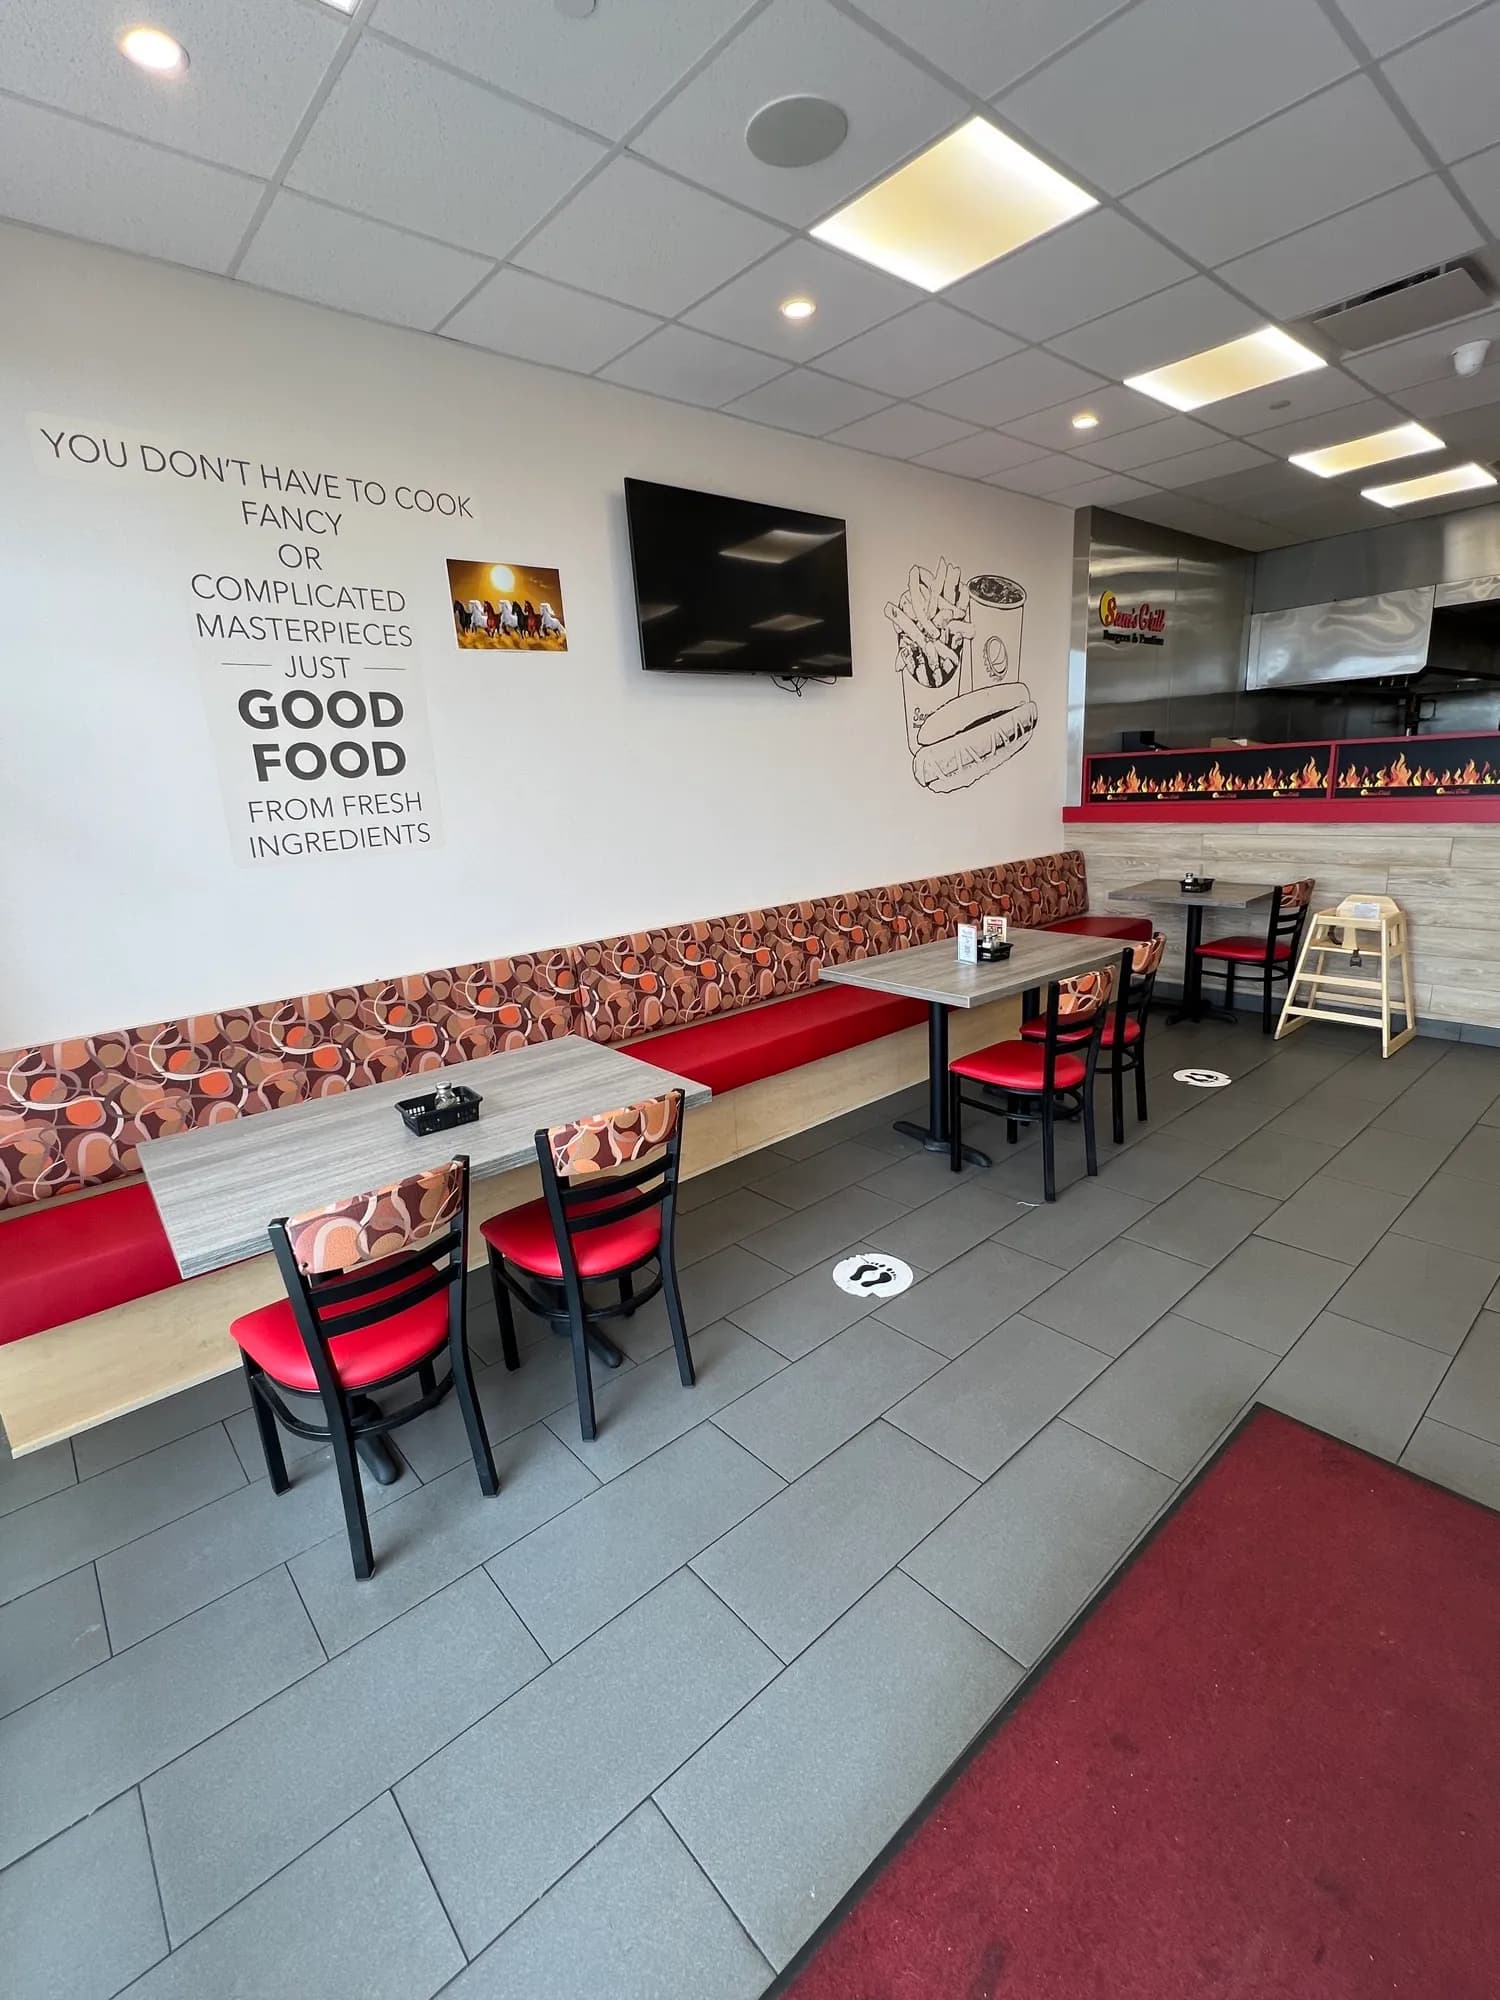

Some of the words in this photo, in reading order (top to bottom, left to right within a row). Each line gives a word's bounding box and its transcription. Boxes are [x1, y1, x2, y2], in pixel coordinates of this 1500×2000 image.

[40, 428, 127, 468] YOU
[140, 445, 251, 487] DON'T
[260, 465, 341, 500] HAVE
[346, 478, 387, 507] TO
[395, 486, 474, 519] COOK
[241, 501, 342, 537] FANCY
[278, 543, 322, 571] OR
[191, 573, 406, 613] COMPLICATED
[195, 614, 413, 648] MASTERPIECES
[1139, 603, 1167, 633] Grill
[284, 655, 351, 680] JUST
[238, 688, 405, 730] GOOD
[252, 741, 407, 782] FOOD
[248, 797, 334, 823] FROM
[342, 791, 423, 817] FRESH
[249, 823, 431, 859] INGREDIENTS
